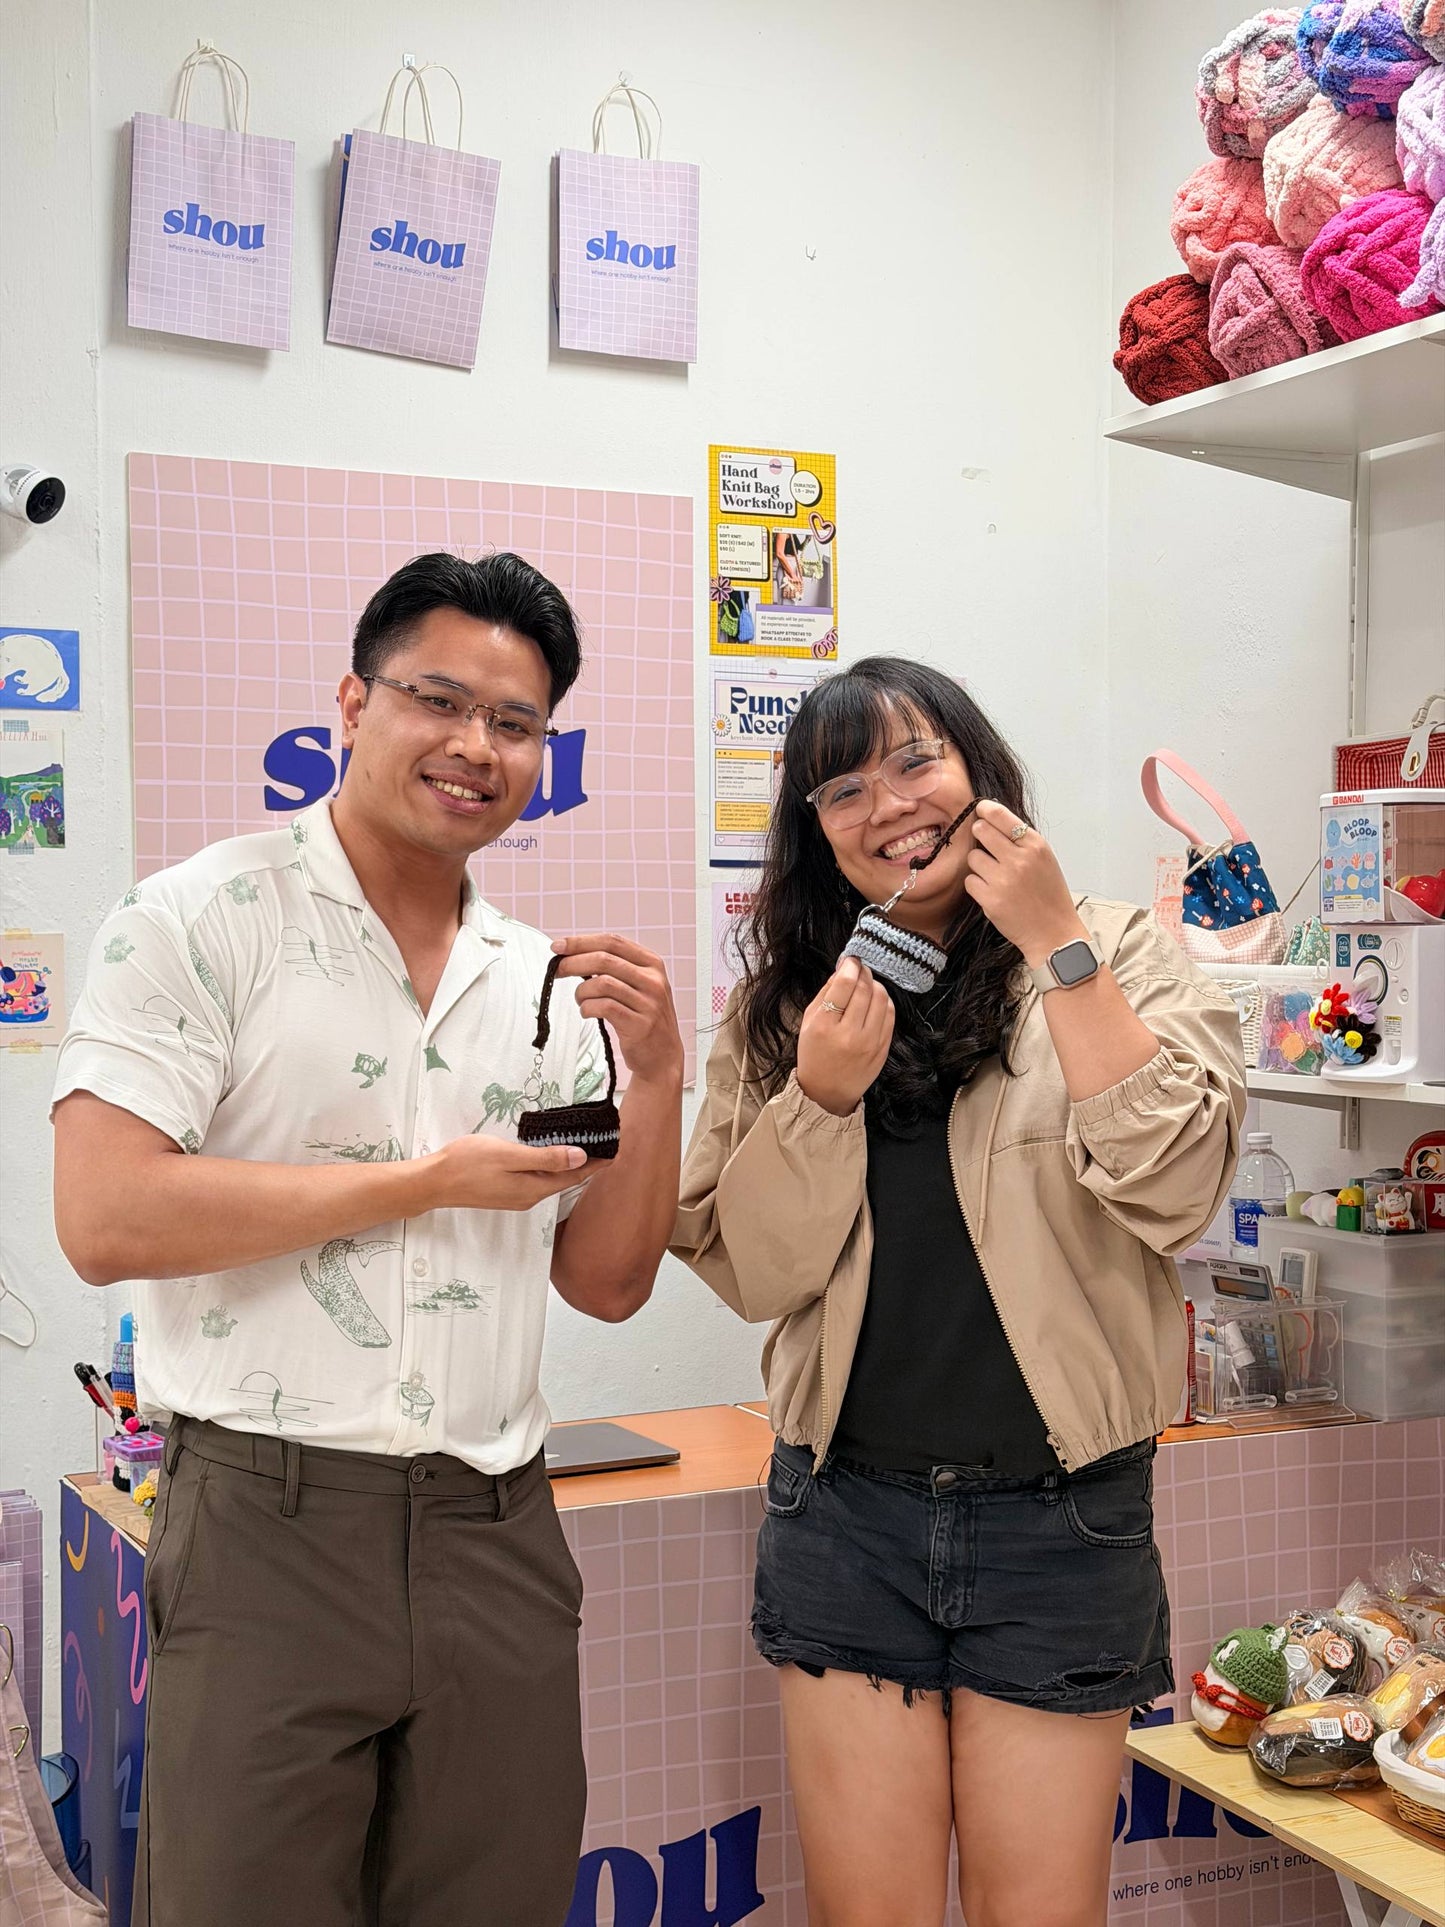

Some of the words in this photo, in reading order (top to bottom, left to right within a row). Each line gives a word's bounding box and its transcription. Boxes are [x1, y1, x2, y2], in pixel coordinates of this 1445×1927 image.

[163, 202, 265, 250] shou
[369, 219, 466, 269] shou
[586, 230, 677, 270] shou
[721, 464, 758, 479] Hand
[721, 479, 751, 493] Knit
[754, 481, 780, 500] Bag
[722, 494, 794, 514] Workshop
[739, 713, 792, 735] Need
[263, 726, 589, 822] su
[1340, 794, 1365, 805] BANDAI
[1343, 818, 1370, 834] BLOOP
[1350, 827, 1378, 840] BLOOP
[563, 1805, 766, 1927] ou
[1112, 1883, 1160, 1902] where
[1165, 1874, 1193, 1891] one
[1198, 1863, 1245, 1885] hobby
[1249, 1855, 1280, 1875] isn't
